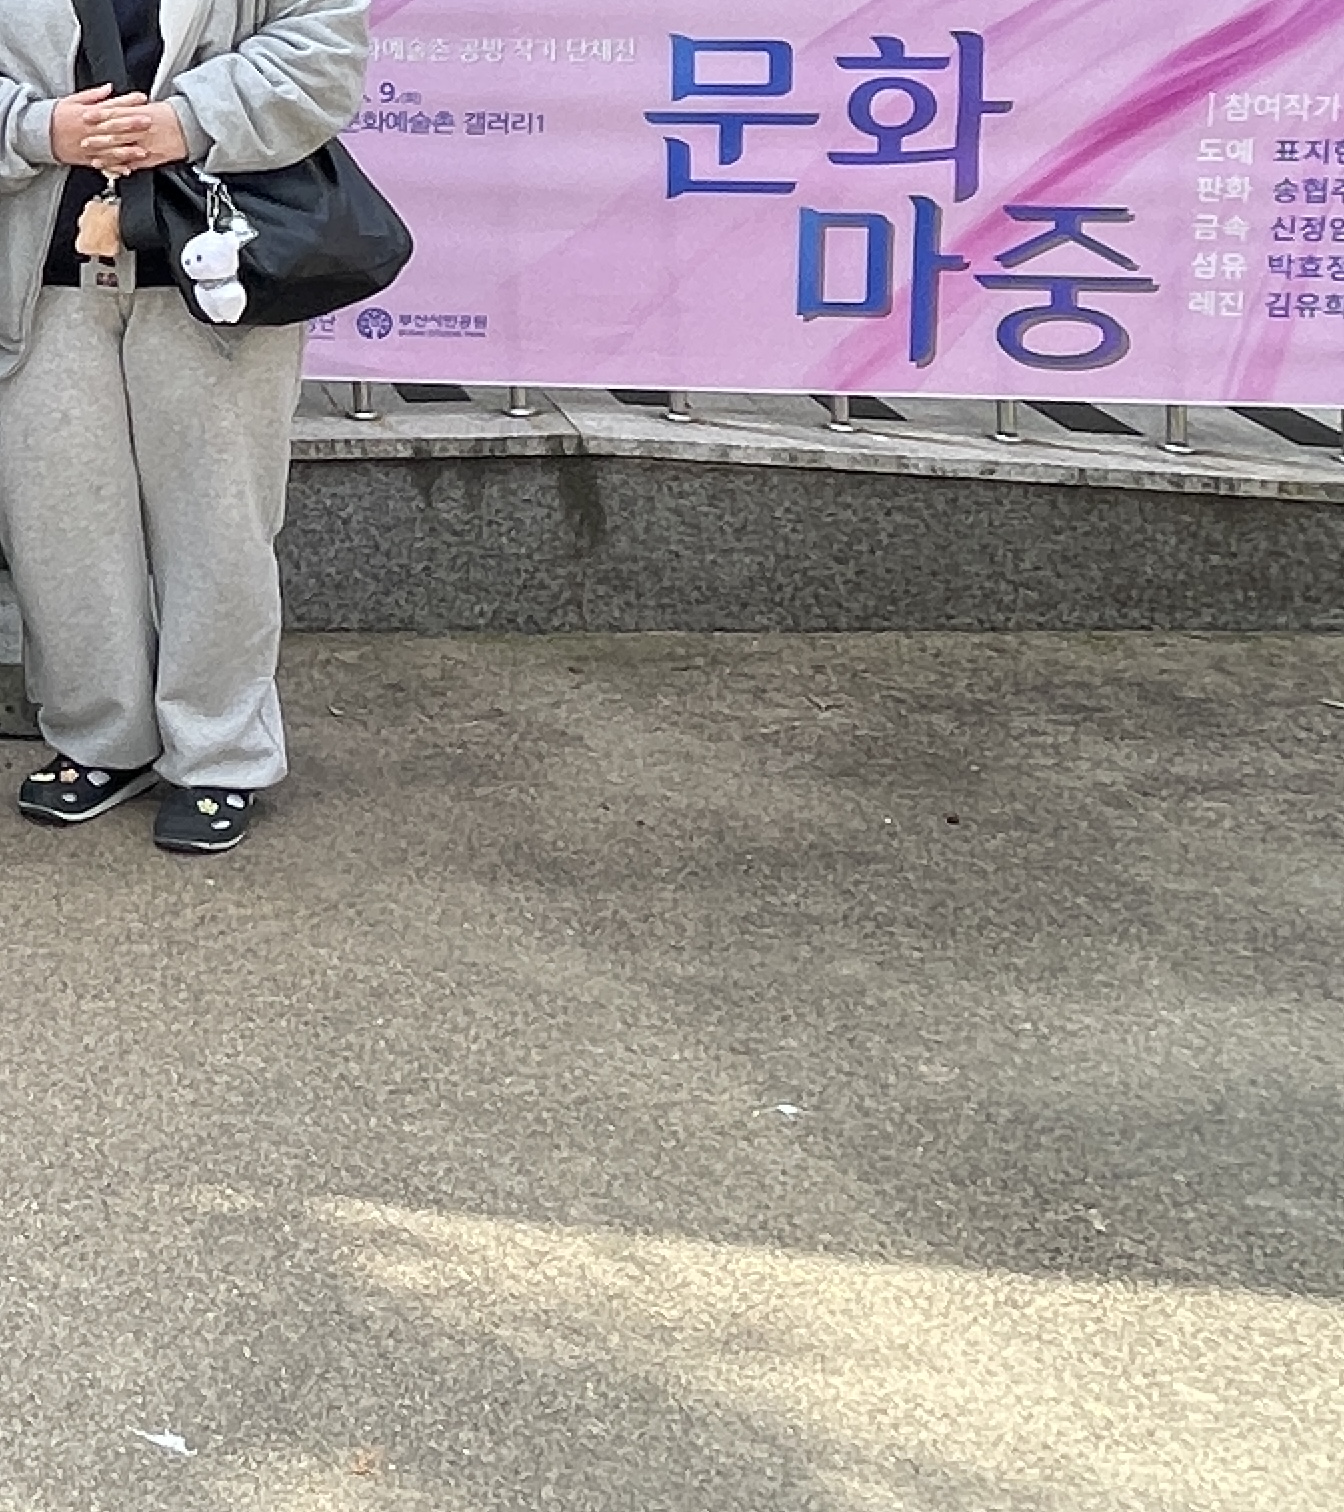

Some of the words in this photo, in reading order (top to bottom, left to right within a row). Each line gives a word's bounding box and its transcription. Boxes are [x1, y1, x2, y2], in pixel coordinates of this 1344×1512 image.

[644, 30, 1013, 203] 문화
[1224, 92, 1341, 122] 참여작가
[464, 111, 544, 136] 갤러리1
[1196, 138, 1255, 165] 도예
[1197, 176, 1253, 204] 판화
[1192, 214, 1250, 241] 금속
[1192, 252, 1248, 280] 섬유
[796, 194, 1160, 371] 마중
[1188, 290, 1244, 317] 레진
